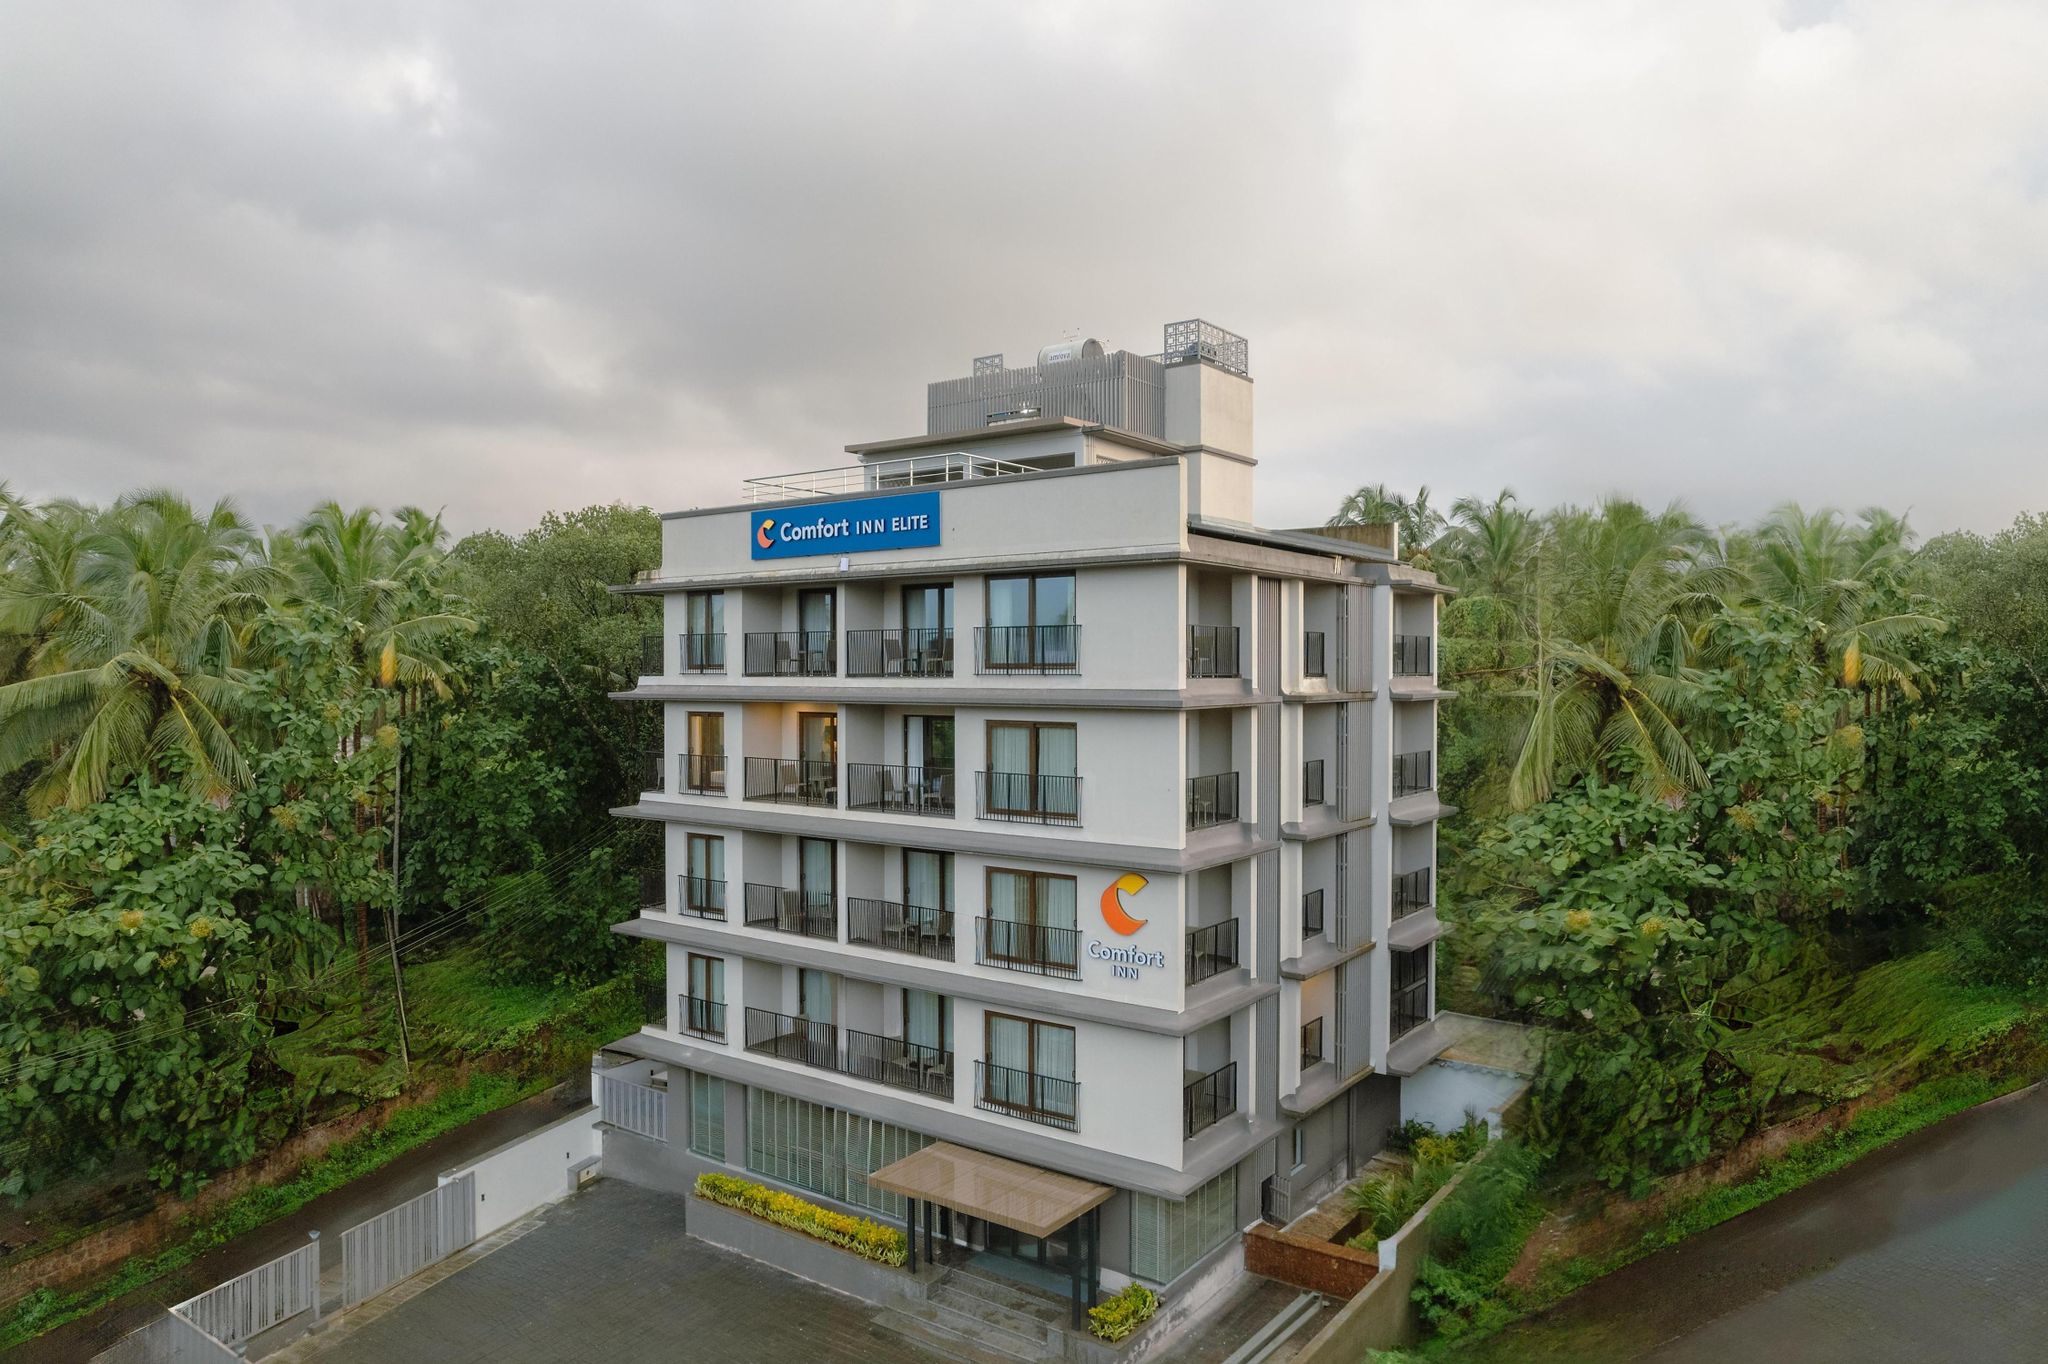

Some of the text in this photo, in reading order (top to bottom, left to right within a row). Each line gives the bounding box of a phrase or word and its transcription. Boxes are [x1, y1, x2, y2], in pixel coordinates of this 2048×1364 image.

[780, 518, 849, 542] Comfort
[856, 519, 885, 535] INN
[893, 515, 928, 531] ELITE
[1088, 940, 1164, 968] Comfort
[1112, 965, 1139, 980] INN
